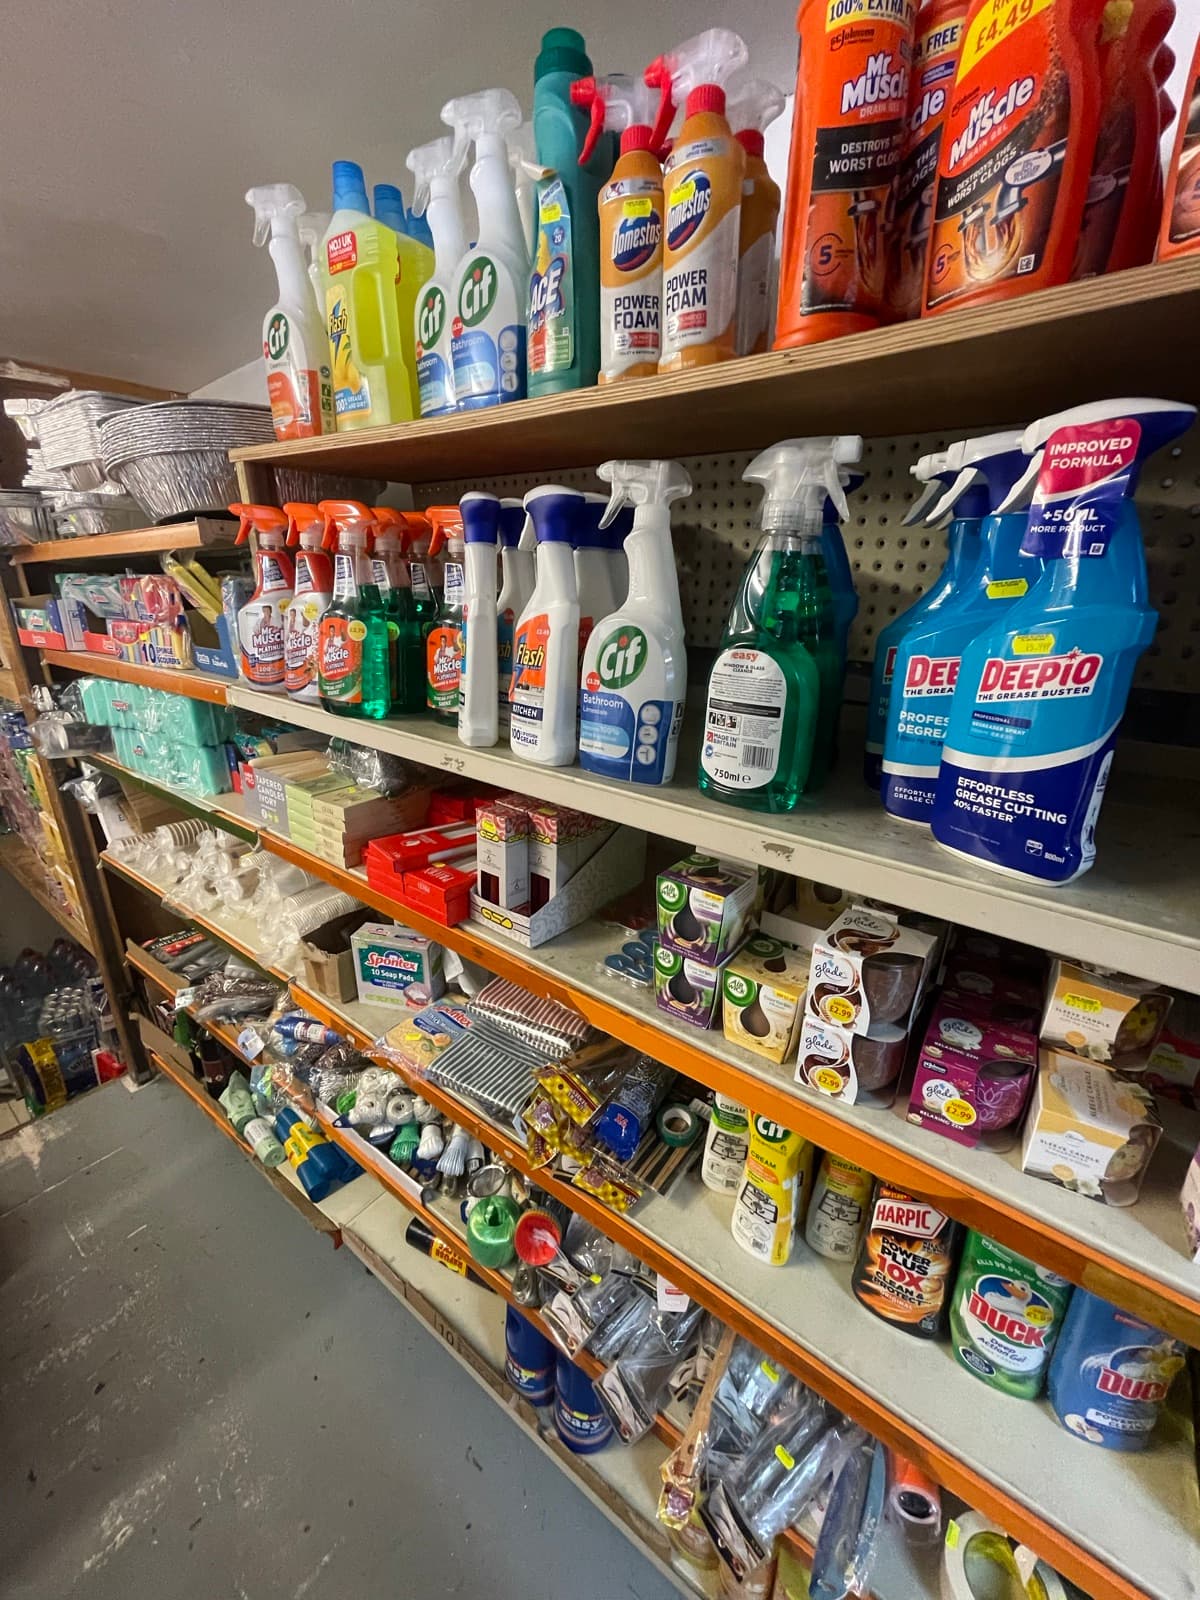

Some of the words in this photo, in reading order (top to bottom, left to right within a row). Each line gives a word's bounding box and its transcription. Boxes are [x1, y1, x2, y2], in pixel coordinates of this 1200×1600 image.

[975, 0, 1034, 54] £4.49
[926, 25, 958, 53] FREE
[860, 104, 887, 119] DRAIN
[841, 138, 891, 155] DESTROYS
[830, 155, 873, 174] WORST
[956, 155, 994, 191] DESTROYS
[994, 141, 1012, 164] THE
[948, 181, 979, 209] WORST
[980, 147, 1018, 184] CLOGS
[611, 219, 662, 261] Domestos
[817, 245, 833, 265] 5
[935, 254, 946, 274] 5
[461, 264, 493, 320] Cif
[667, 269, 707, 296] POWER
[530, 269, 562, 319] ACE
[615, 295, 659, 311] POWER
[667, 287, 708, 316] FOAM
[420, 294, 443, 345] Cif
[615, 311, 659, 331] FOAM
[268, 318, 288, 354] Cif
[452, 335, 485, 352] Bathroom
[1050, 437, 1132, 456] IMPROVED
[1050, 453, 1123, 469] FORMULA
[1030, 525, 1056, 534] MORE
[142, 643, 156, 663] 10
[517, 644, 545, 667] Flash
[600, 634, 642, 682] Cif
[731, 651, 759, 663] easy
[433, 659, 461, 675] Muscle
[926, 687, 954, 695] GREA
[978, 693, 994, 701] THE
[996, 690, 1038, 699] GREASE
[1041, 686, 1090, 697] BUSTER
[512, 705, 538, 717] KITCHEN
[582, 693, 624, 710] Bathroom
[899, 710, 950, 727] PROFES
[897, 722, 948, 739] DEGRE
[255, 774, 283, 792] TAPERED
[714, 768, 740, 783] 750ml
[257, 784, 285, 802] CANDLES
[258, 793, 277, 807] IVORY
[893, 792, 923, 804] GREASE
[956, 776, 1035, 805] EFFORTLESS
[953, 799, 971, 812] 40%
[956, 787, 1001, 809] GREASE
[1004, 801, 1067, 826] CUTTING
[366, 952, 418, 971] Spontex
[814, 961, 845, 978] glade
[380, 969, 398, 980] Soap
[398, 972, 415, 982] Pads
[829, 1004, 852, 1019] £2.99
[805, 1035, 834, 1050] glade
[818, 1076, 840, 1089] £2.99
[926, 1084, 953, 1098] glade
[719, 1103, 746, 1114] CREAM
[946, 1105, 972, 1121] £2.99
[919, 1109, 951, 1126] RELAXING
[951, 1121, 965, 1131] ZEN
[750, 1149, 777, 1169] CREAM
[831, 1158, 863, 1173] CREAM
[876, 1204, 932, 1230] HARPIC
[880, 1244, 929, 1277] PLUS
[881, 1235, 932, 1268] POWER
[876, 1253, 925, 1294] 10X
[872, 1275, 927, 1306] PROTECT
[875, 1270, 915, 1297] CLEAN
[916, 1291, 925, 1300] &
[968, 1291, 1049, 1348] DUCK
[976, 1336, 1010, 1357] Action
[990, 1337, 1017, 1354] Deep
